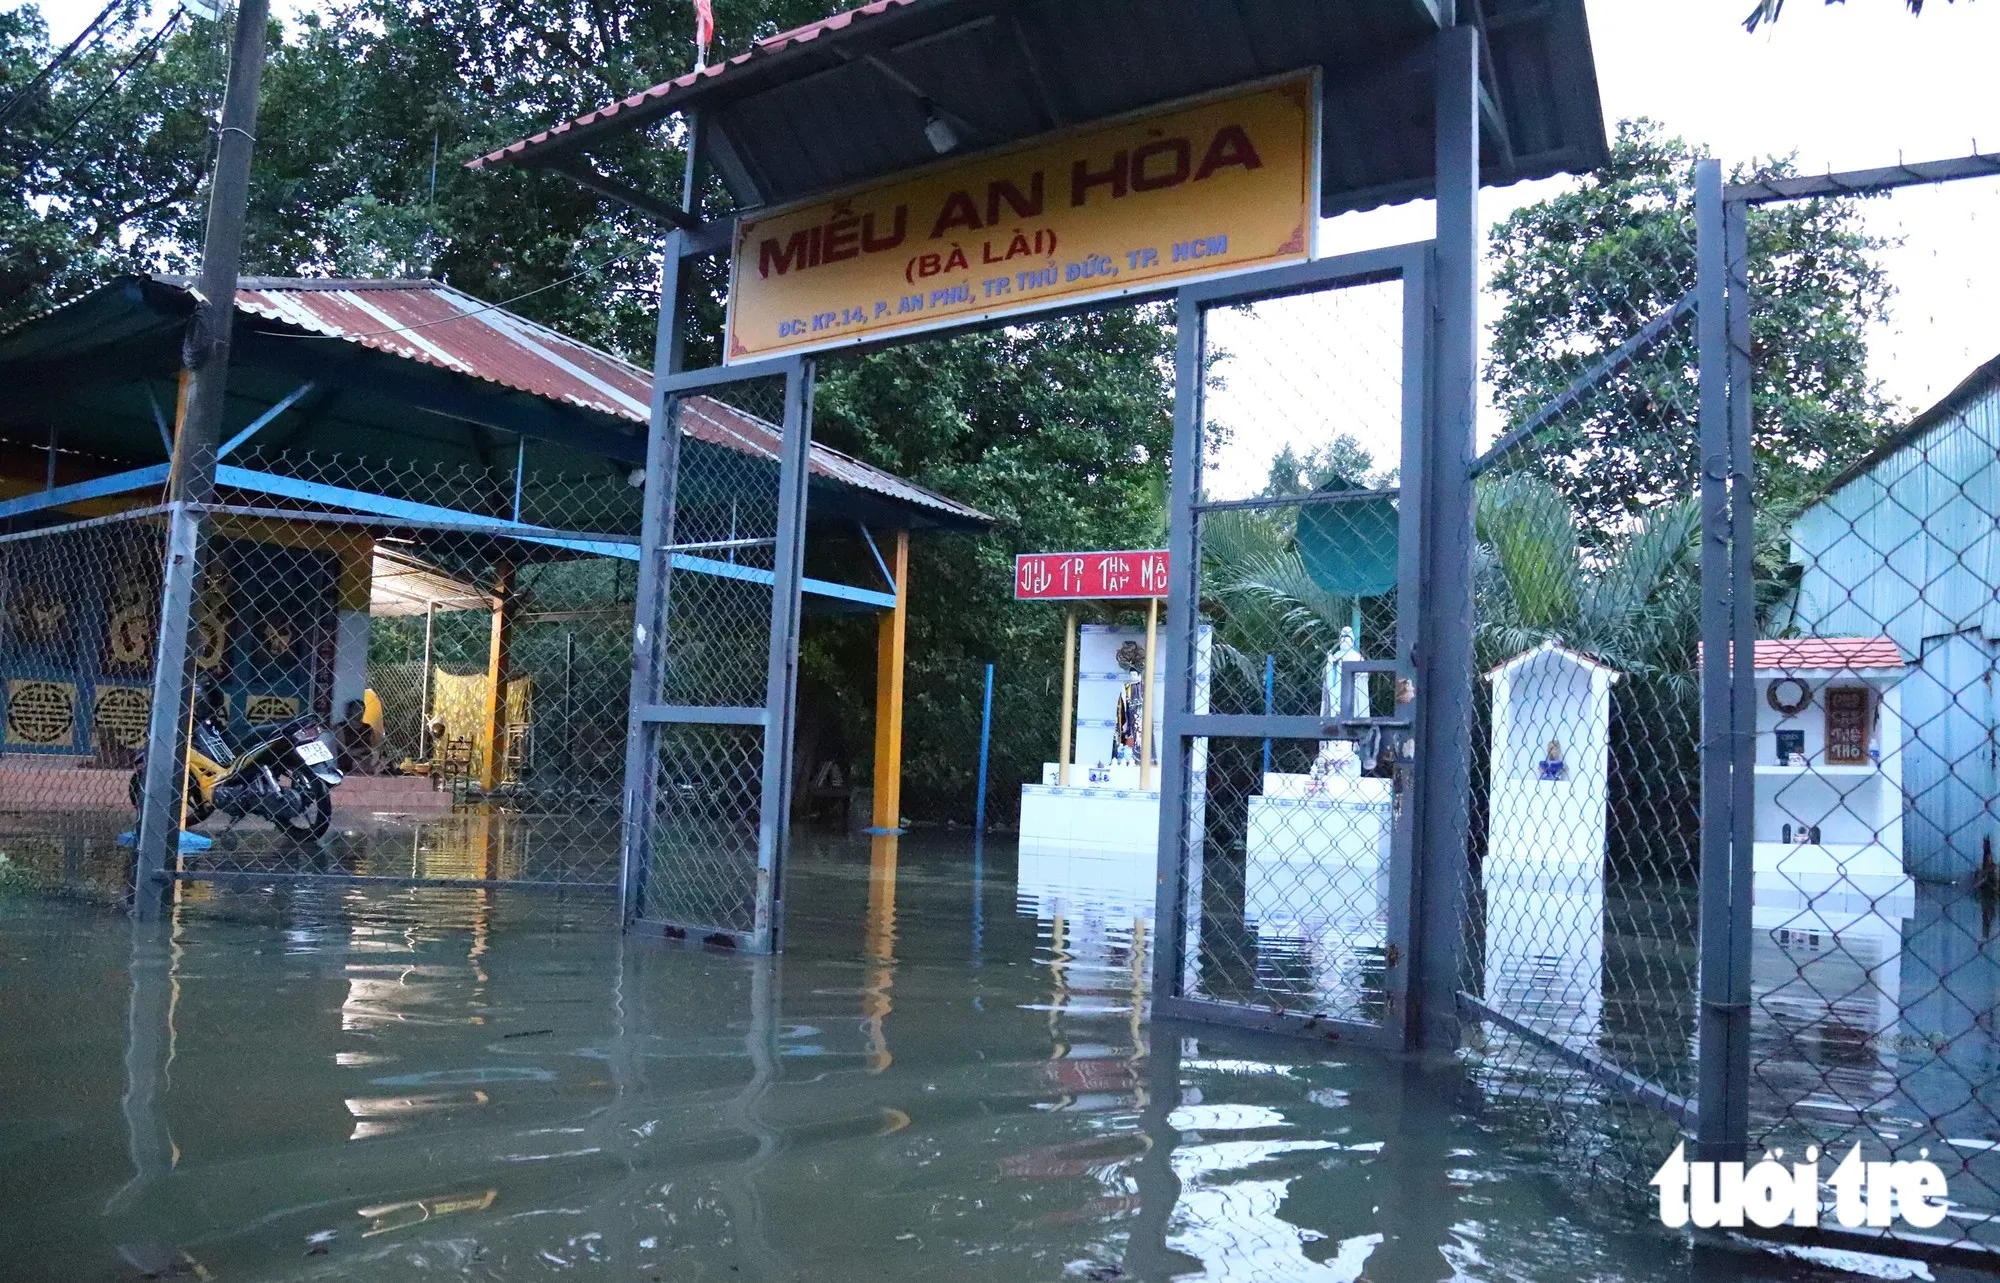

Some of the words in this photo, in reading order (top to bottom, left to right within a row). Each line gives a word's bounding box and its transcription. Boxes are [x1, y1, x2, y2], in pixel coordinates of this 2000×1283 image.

[928, 171, 1044, 240] AN
[1071, 124, 1264, 208] HÒA
[779, 318, 807, 338] ĐC:
[874, 301, 892, 319] P.
[898, 293, 924, 315] AN
[930, 278, 976, 309] PHÚ,
[1065, 253, 1119, 283] ĐỨC,
[1126, 248, 1159, 270] TP.
[1172, 234, 1228, 263] HCM
[905, 243, 968, 285] (BÀ
[983, 228, 1057, 264] LÀI)
